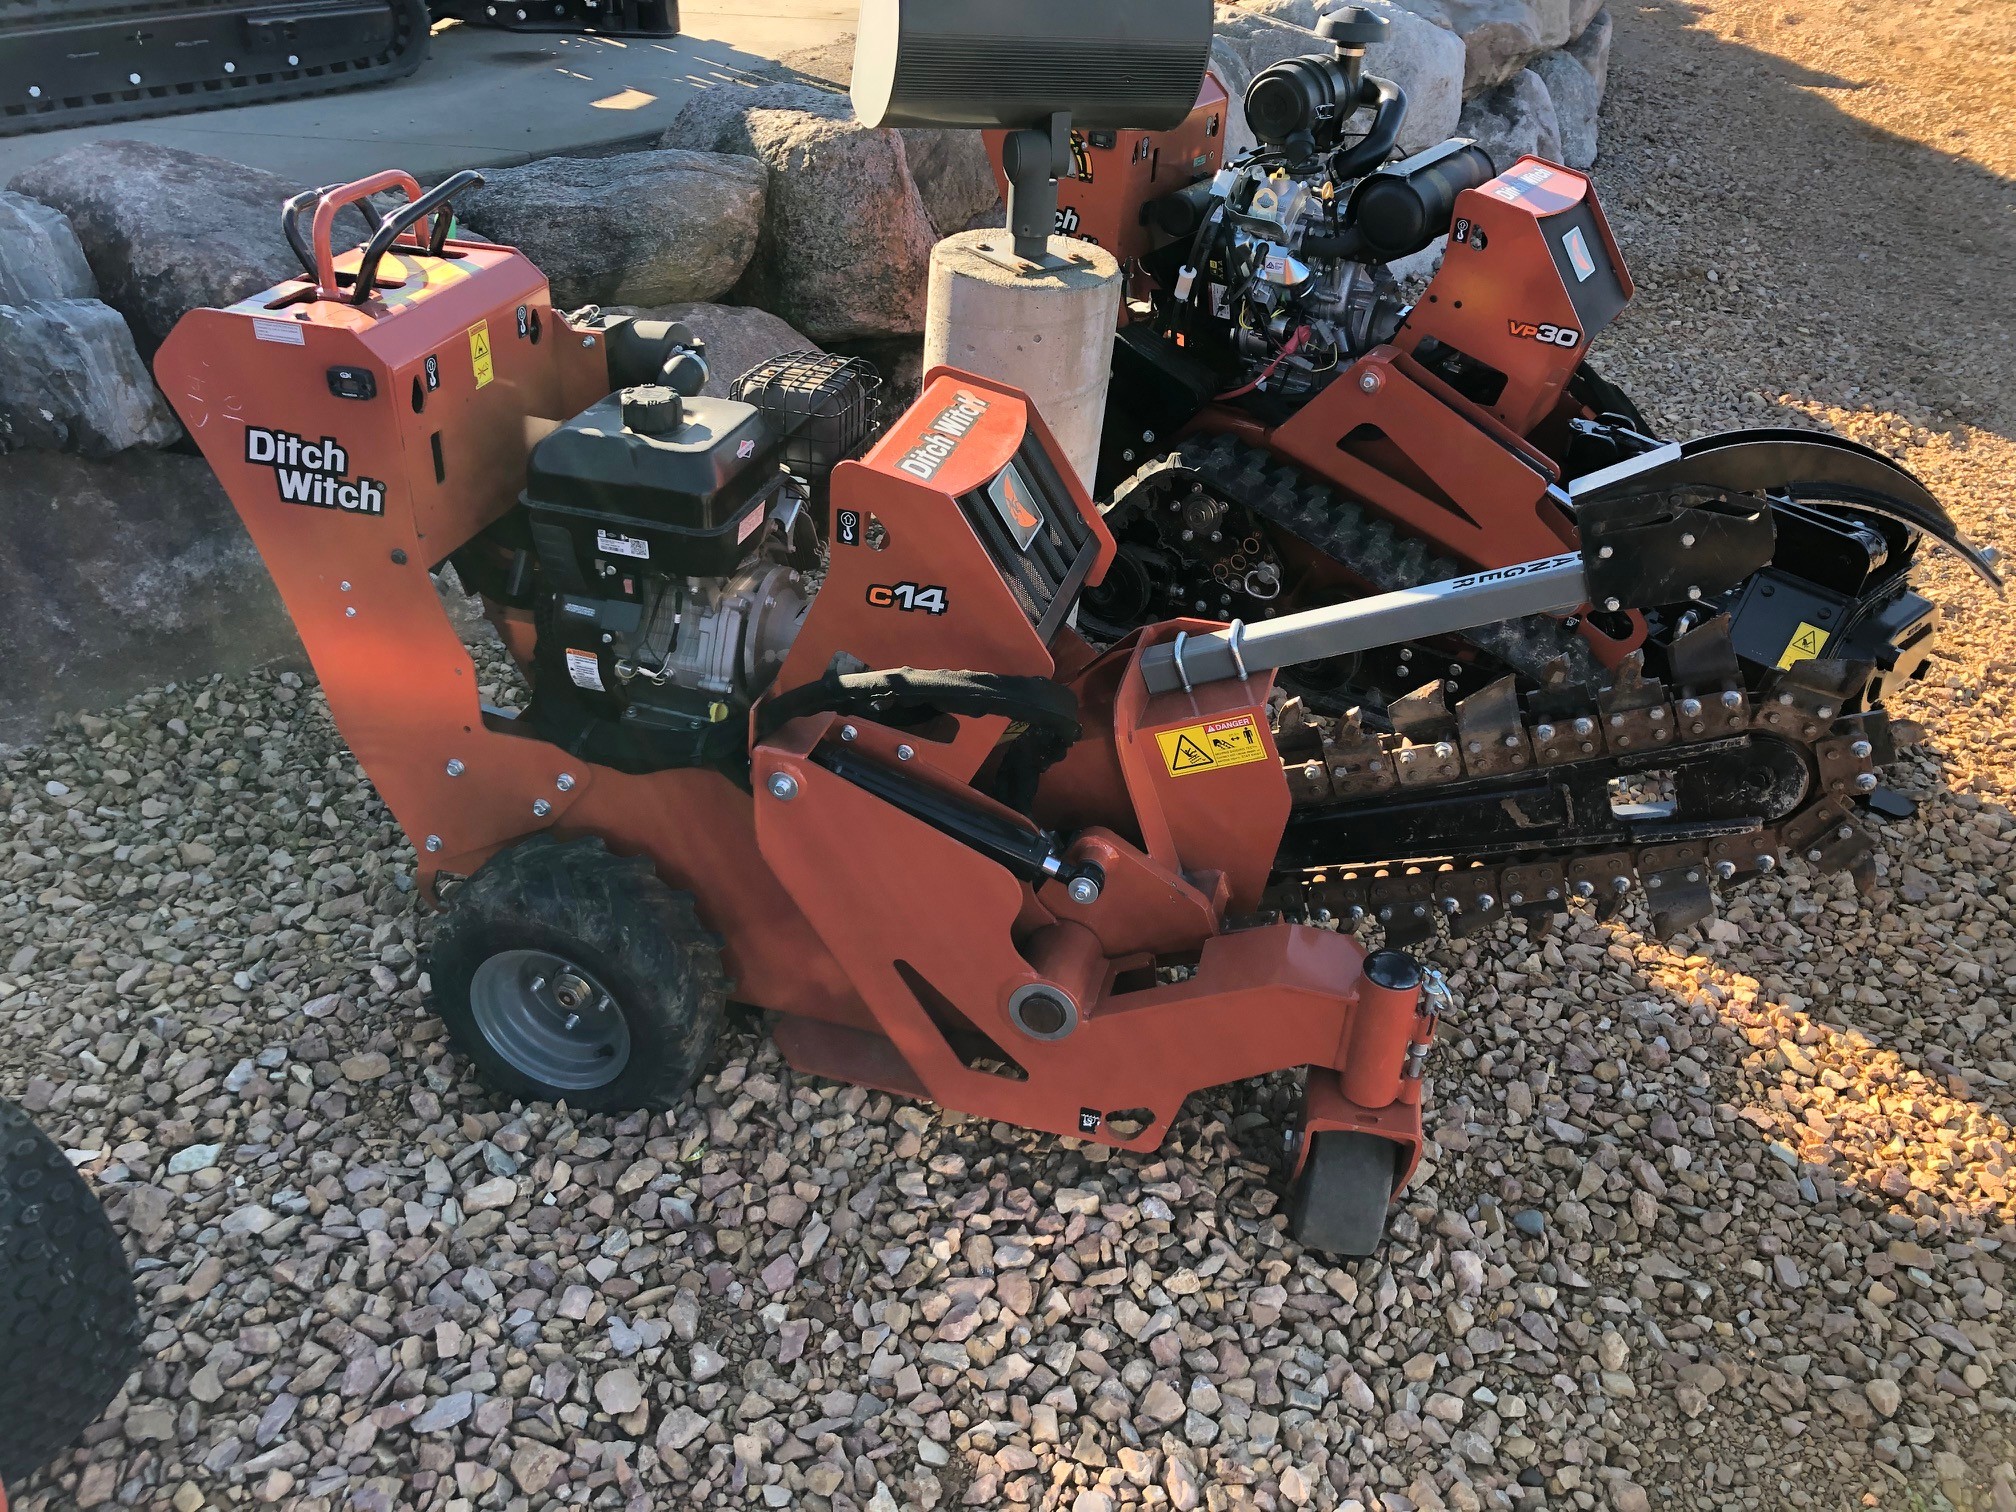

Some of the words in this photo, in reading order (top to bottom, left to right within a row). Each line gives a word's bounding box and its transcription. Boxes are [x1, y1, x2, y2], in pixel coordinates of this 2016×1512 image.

[1510, 321, 1579, 347] VP30
[249, 429, 345, 473] Ditch
[901, 435, 955, 479] Ditch
[933, 396, 987, 437] Witch
[278, 469, 381, 512] Witch
[869, 584, 945, 612] C14
[1215, 717, 1250, 731] DANGER
